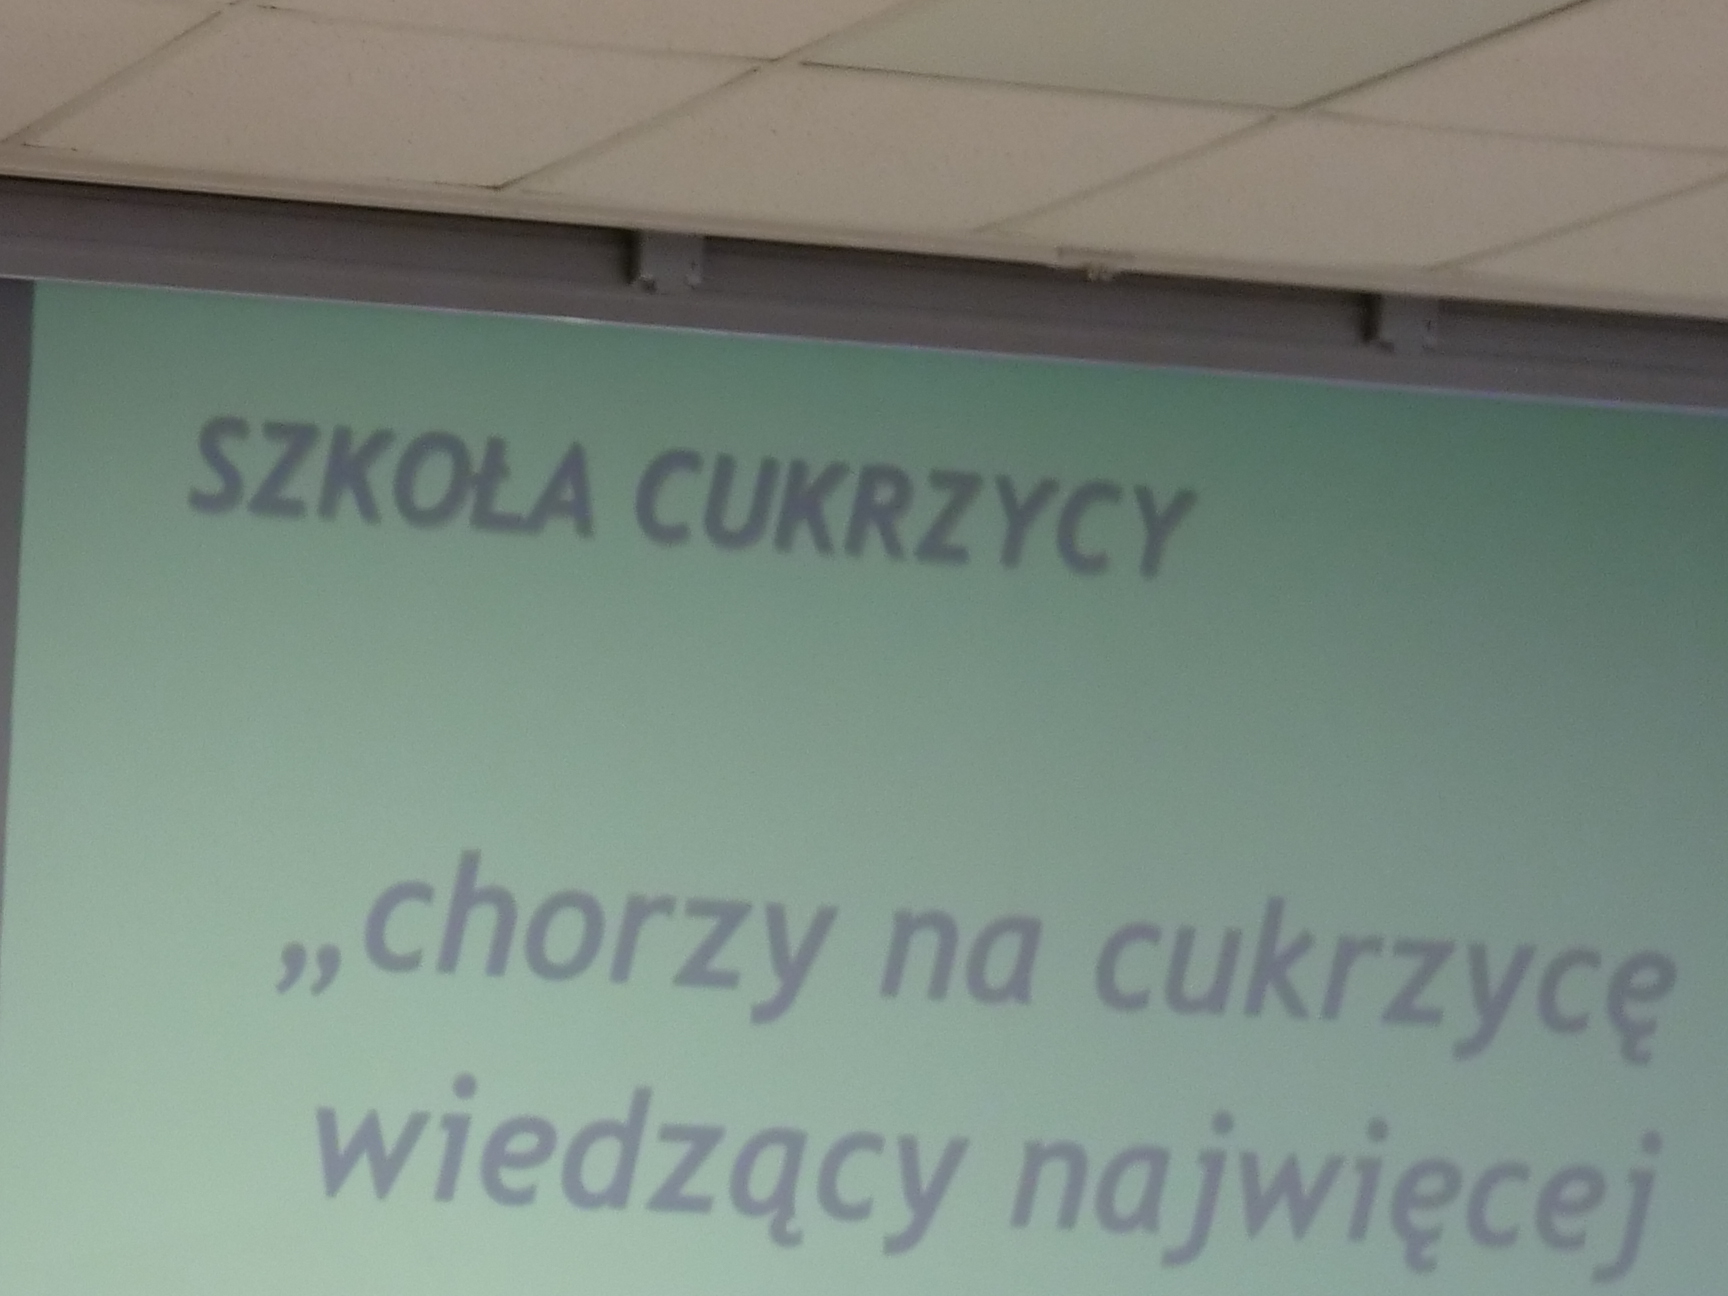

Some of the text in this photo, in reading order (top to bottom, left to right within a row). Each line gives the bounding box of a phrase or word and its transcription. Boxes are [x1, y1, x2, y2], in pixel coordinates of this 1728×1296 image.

[188, 414, 1197, 579] SZKOŁA CUKRZYCY
[275, 848, 1678, 1066] „chorzy na cukrzycę
[315, 1073, 1663, 1284] wiedzący najwięcej
